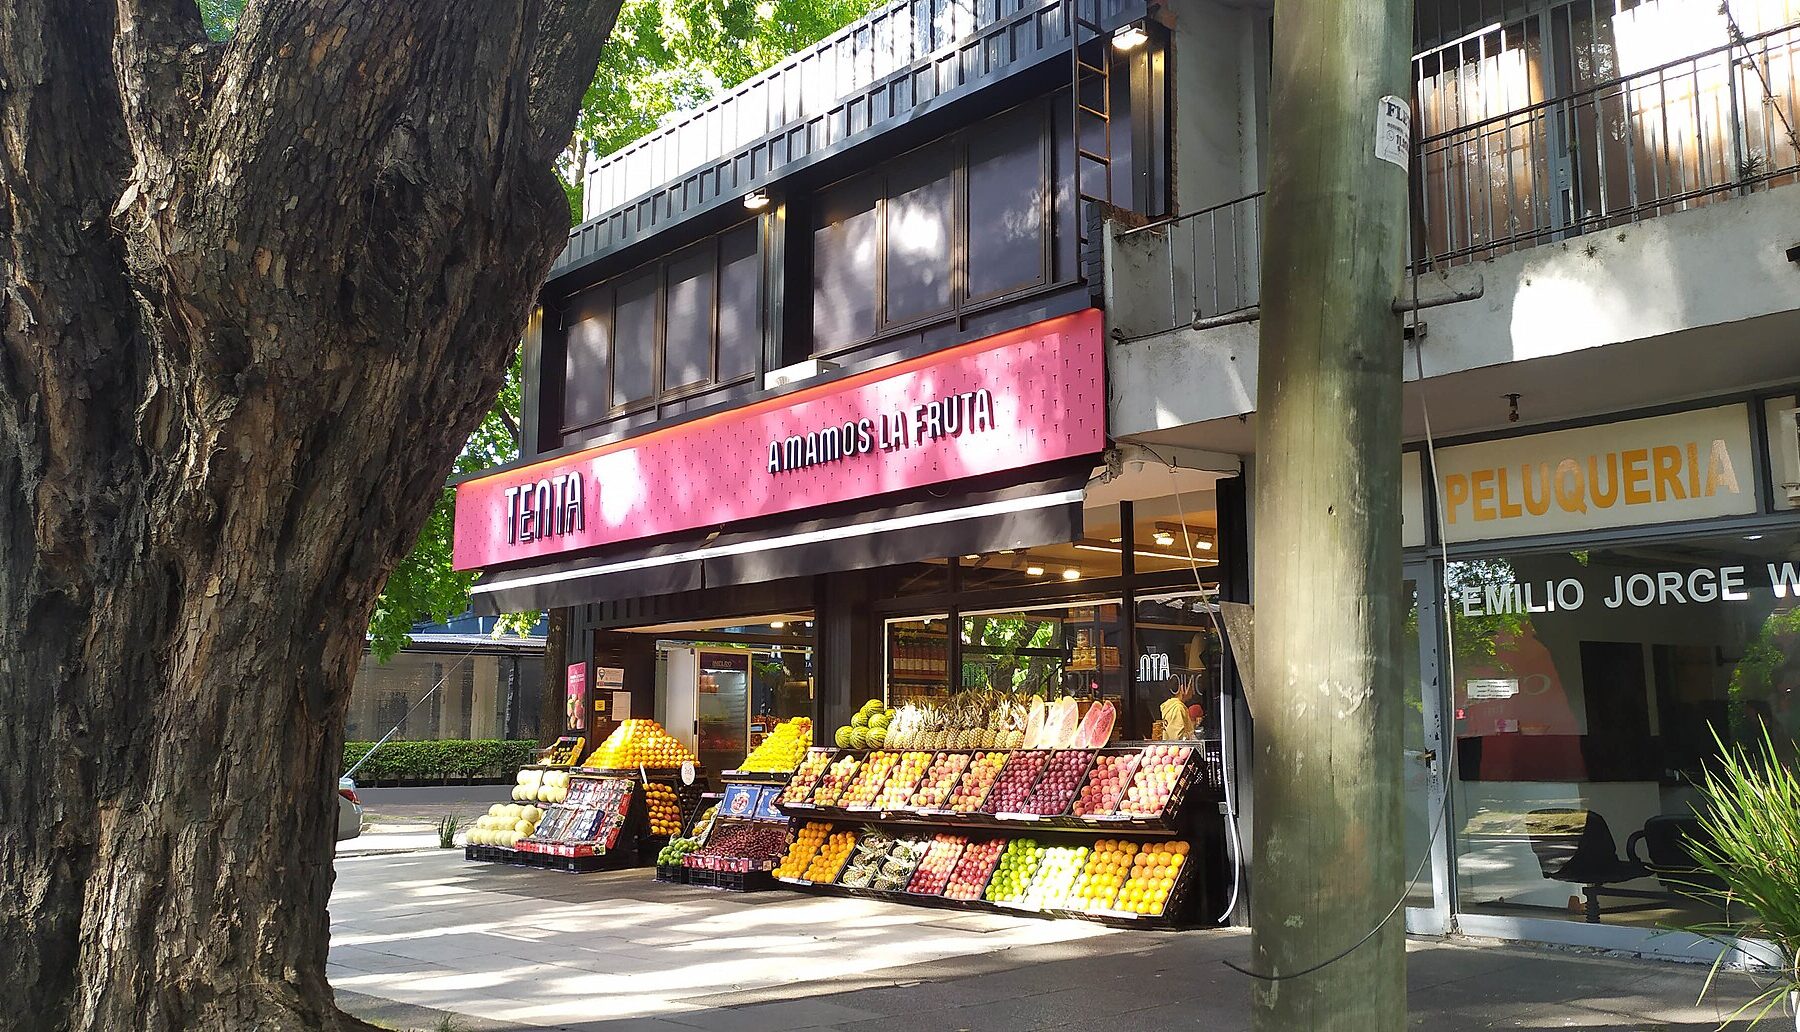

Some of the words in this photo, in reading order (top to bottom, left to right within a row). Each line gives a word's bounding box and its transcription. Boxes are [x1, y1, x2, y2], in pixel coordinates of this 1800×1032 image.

[768, 418, 872, 474] AMAMOS
[878, 411, 906, 451] LA
[914, 388, 994, 444] FRUTA
[505, 470, 584, 545] TENTA
[1445, 439, 1740, 525] PELUQUERIA
[1463, 578, 1584, 617] EMILIO
[1604, 566, 1748, 608] JORGE
